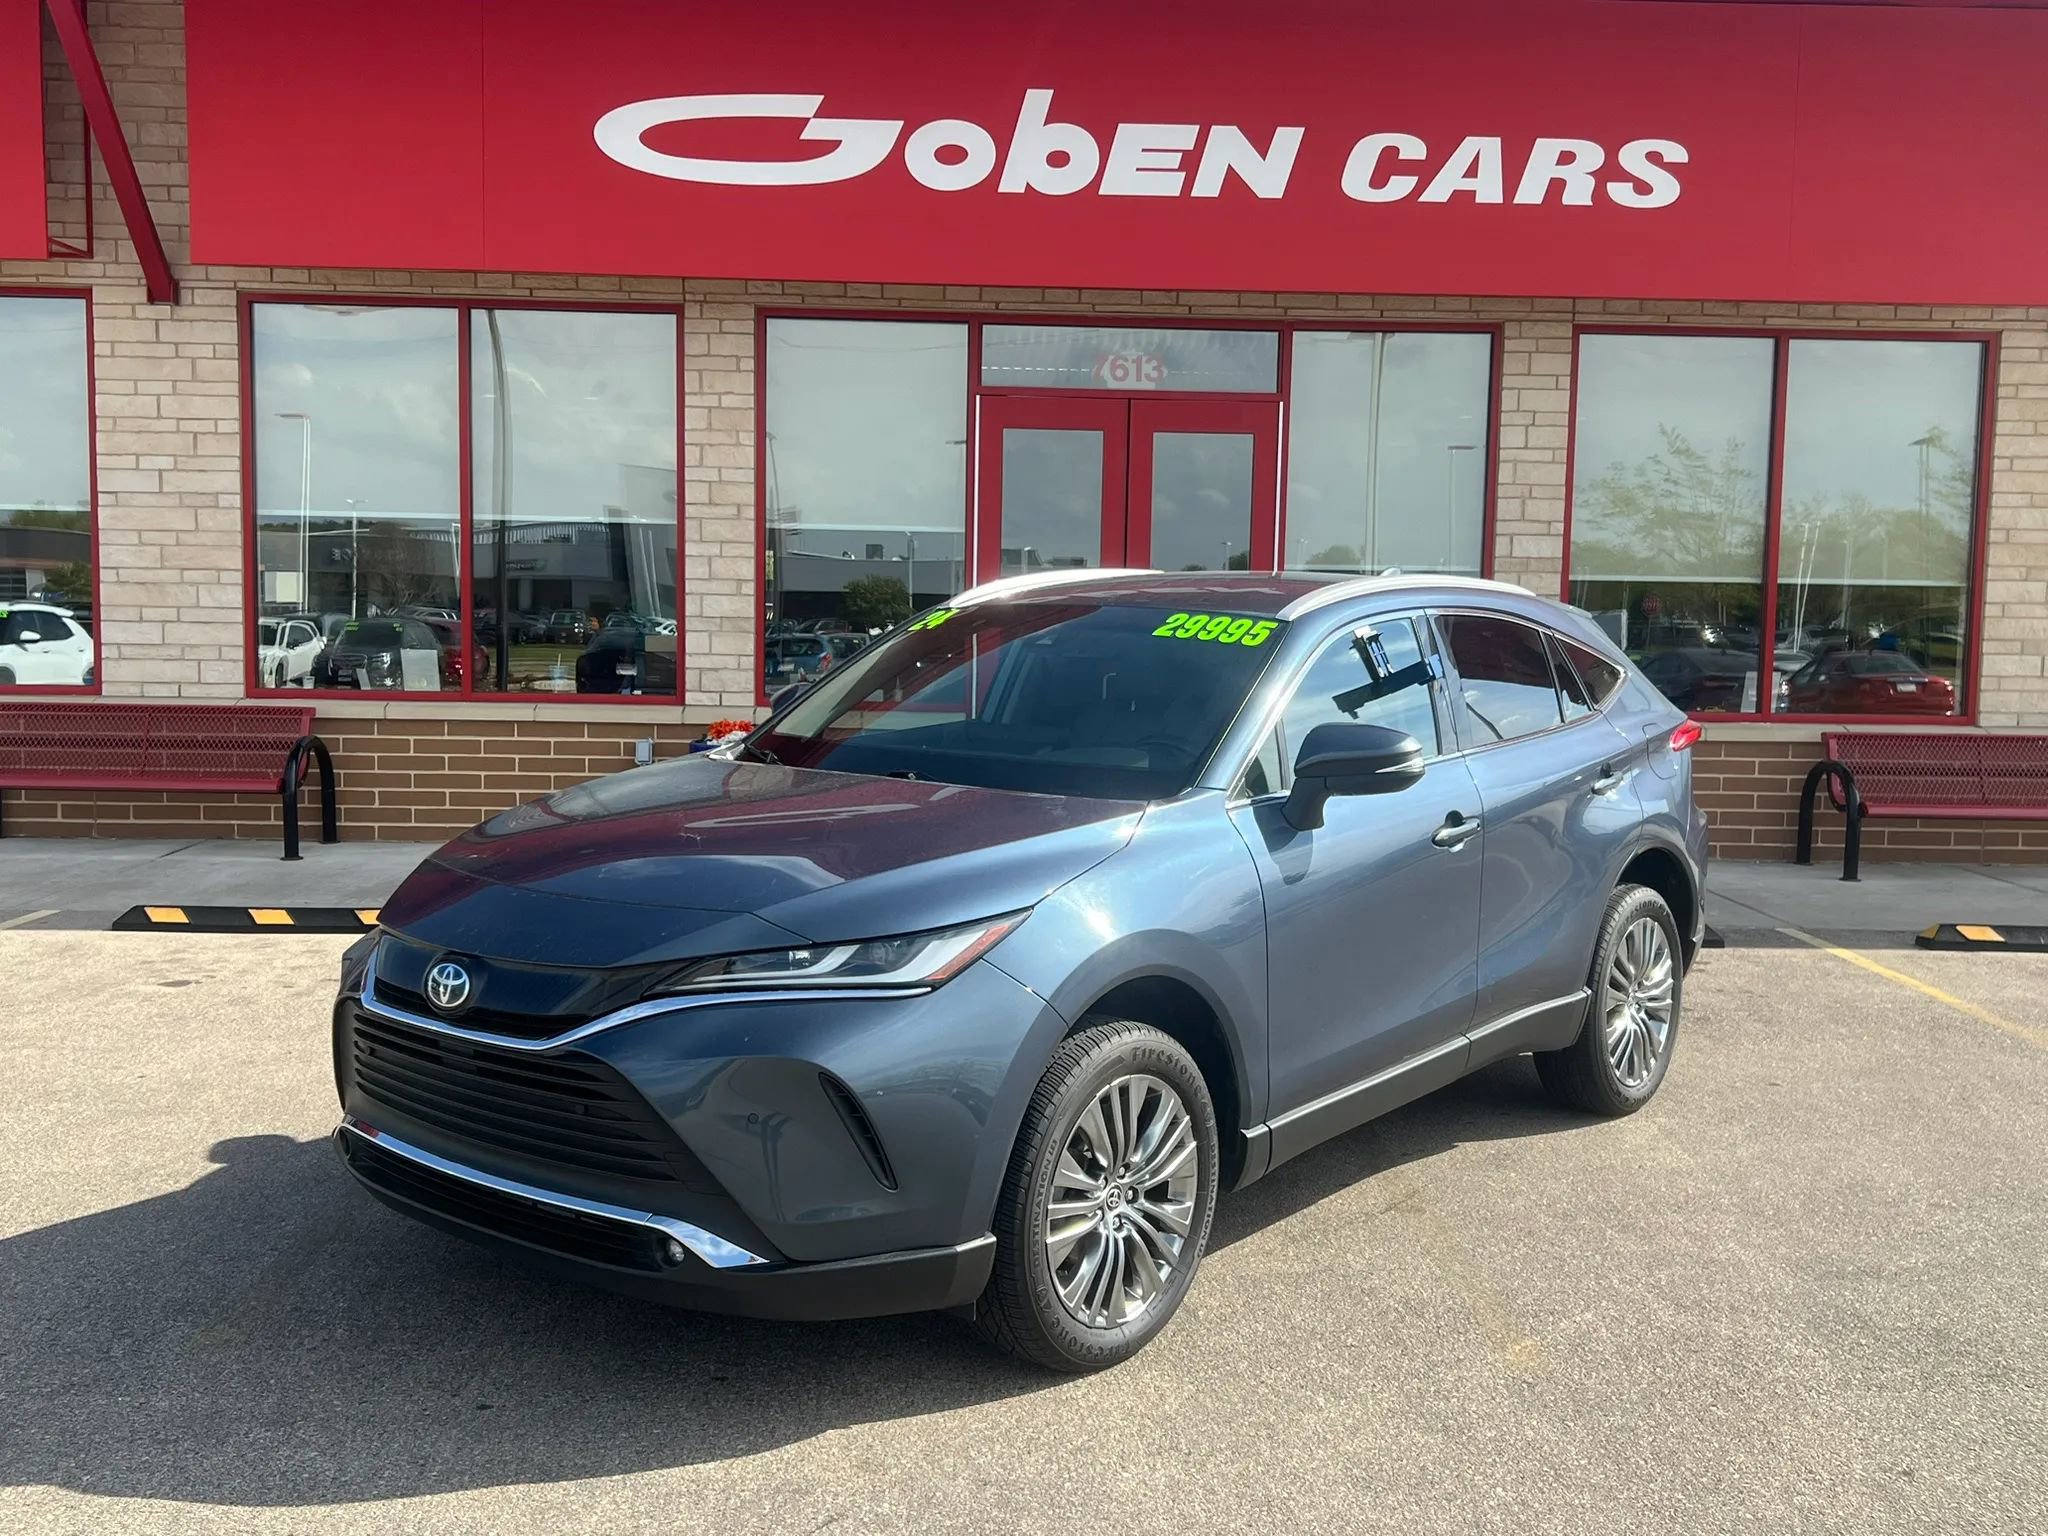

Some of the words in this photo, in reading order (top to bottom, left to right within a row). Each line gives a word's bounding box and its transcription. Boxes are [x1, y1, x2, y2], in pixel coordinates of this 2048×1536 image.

[1340, 132, 1690, 208] CARS
[1092, 353, 1165, 383] 7613
[1151, 612, 1279, 647] 29995
